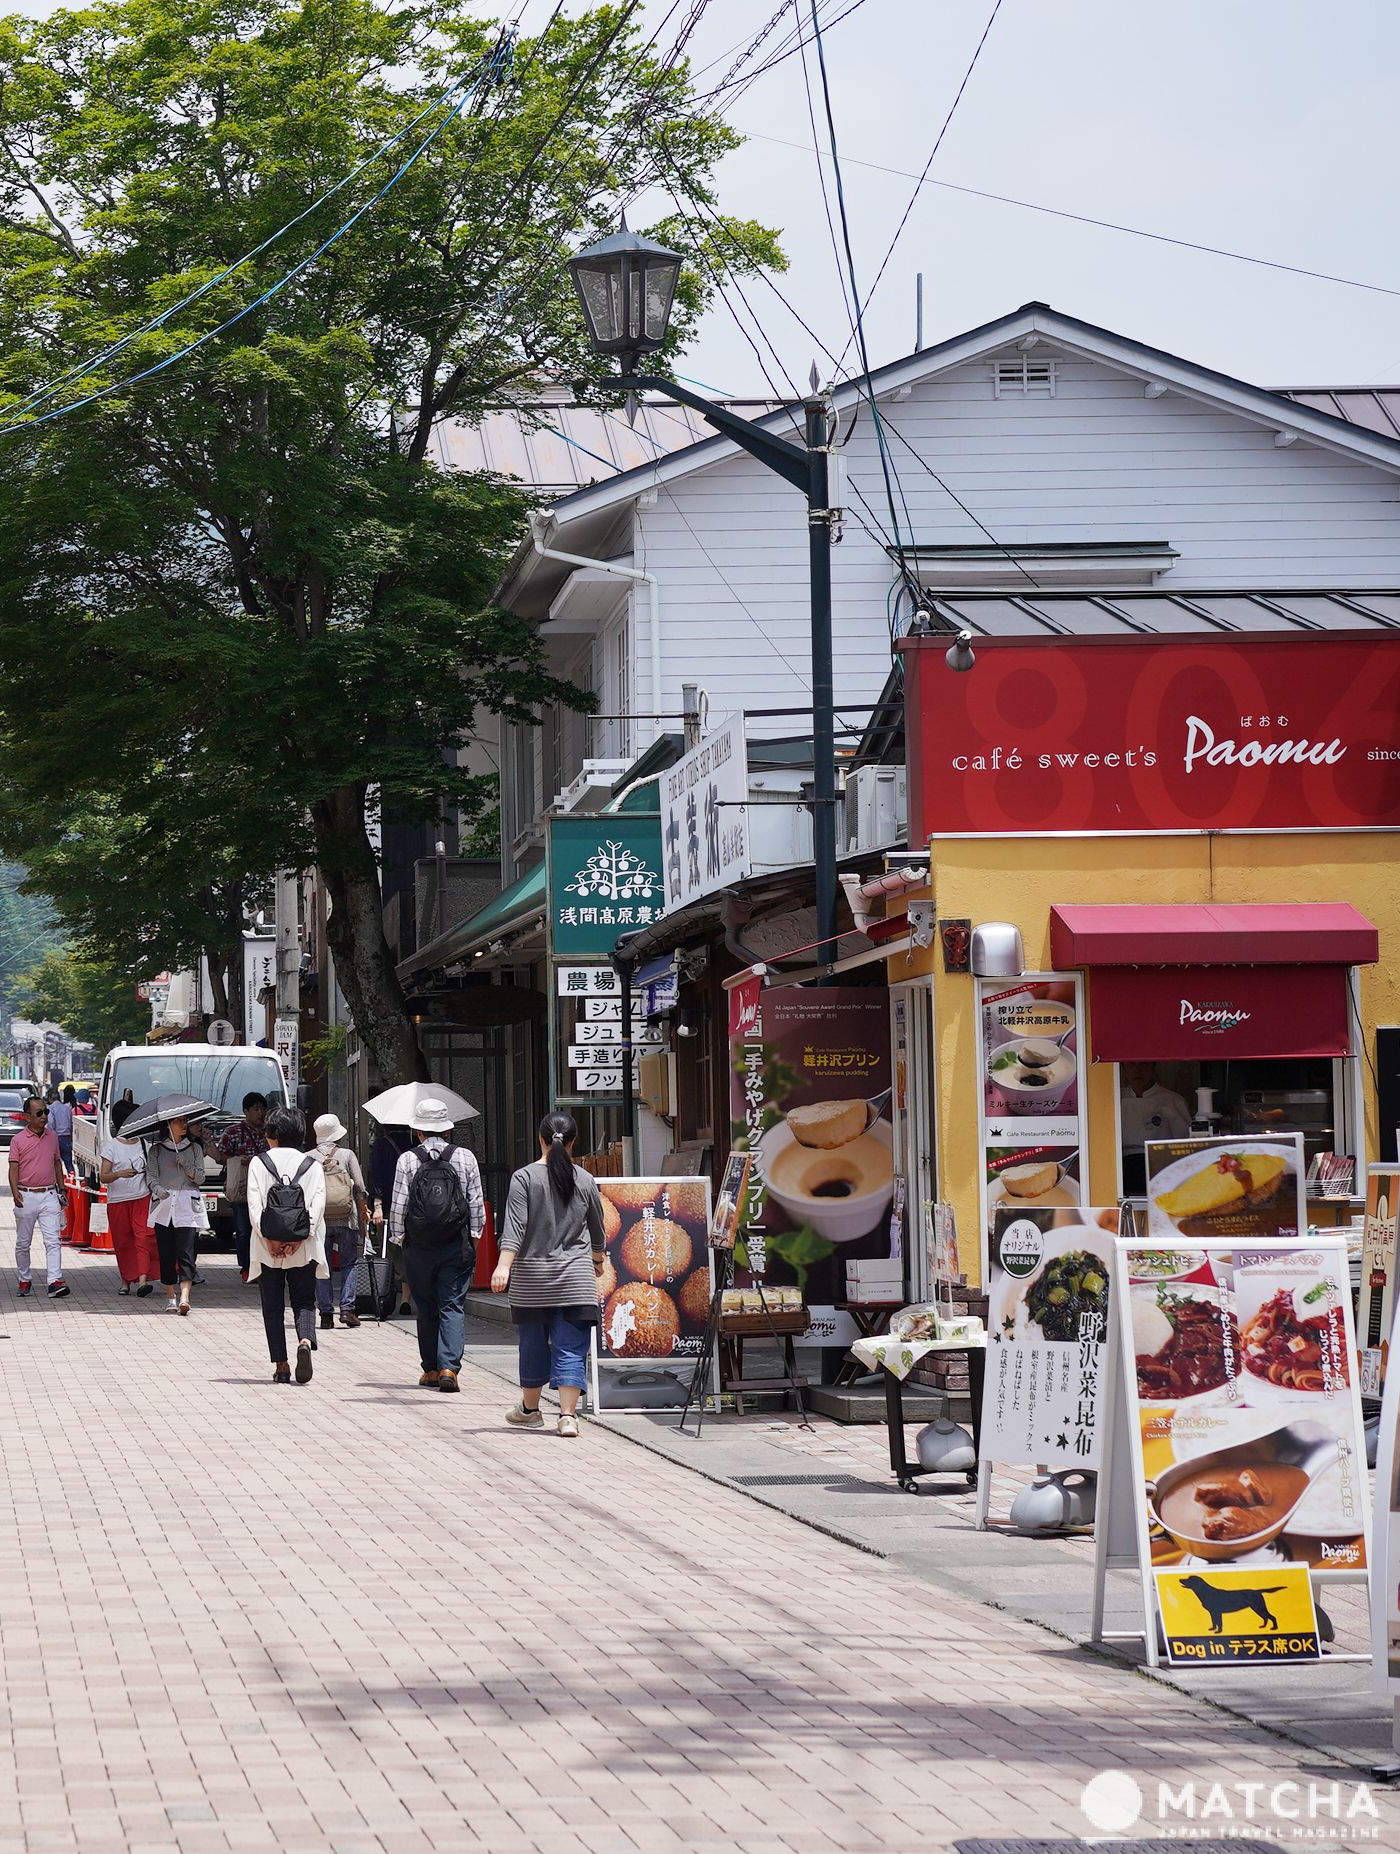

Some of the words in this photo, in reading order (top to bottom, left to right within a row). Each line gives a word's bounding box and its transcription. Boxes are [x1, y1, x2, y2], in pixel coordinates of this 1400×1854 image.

[952, 746, 1023, 771] café
[1038, 745, 1157, 769] sweet's
[1183, 715, 1348, 774] Paomu
[1367, 747, 1400, 761] since
[1179, 999, 1251, 1025] Paomu
[275, 1024, 297, 1032] SAWAYA
[998, 1016, 1070, 1026] 北軽井沢高原牛乳
[279, 1031, 293, 1039] JAM
[803, 1053, 881, 1067] 軽井沢プリン
[845, 1069, 869, 1077] pudding
[1050, 1129, 1076, 1137] Paomu
[1004, 1241, 1040, 1252] オリジナル
[672, 1334, 705, 1350] Paom
[1074, 1311, 1104, 1456] 野沢菜昆布
[1320, 1542, 1360, 1559] Paomu
[1172, 1641, 1207, 1658] Dog
[1209, 1640, 1226, 1655] in
[1228, 1637, 1316, 1656] テラス席OK
